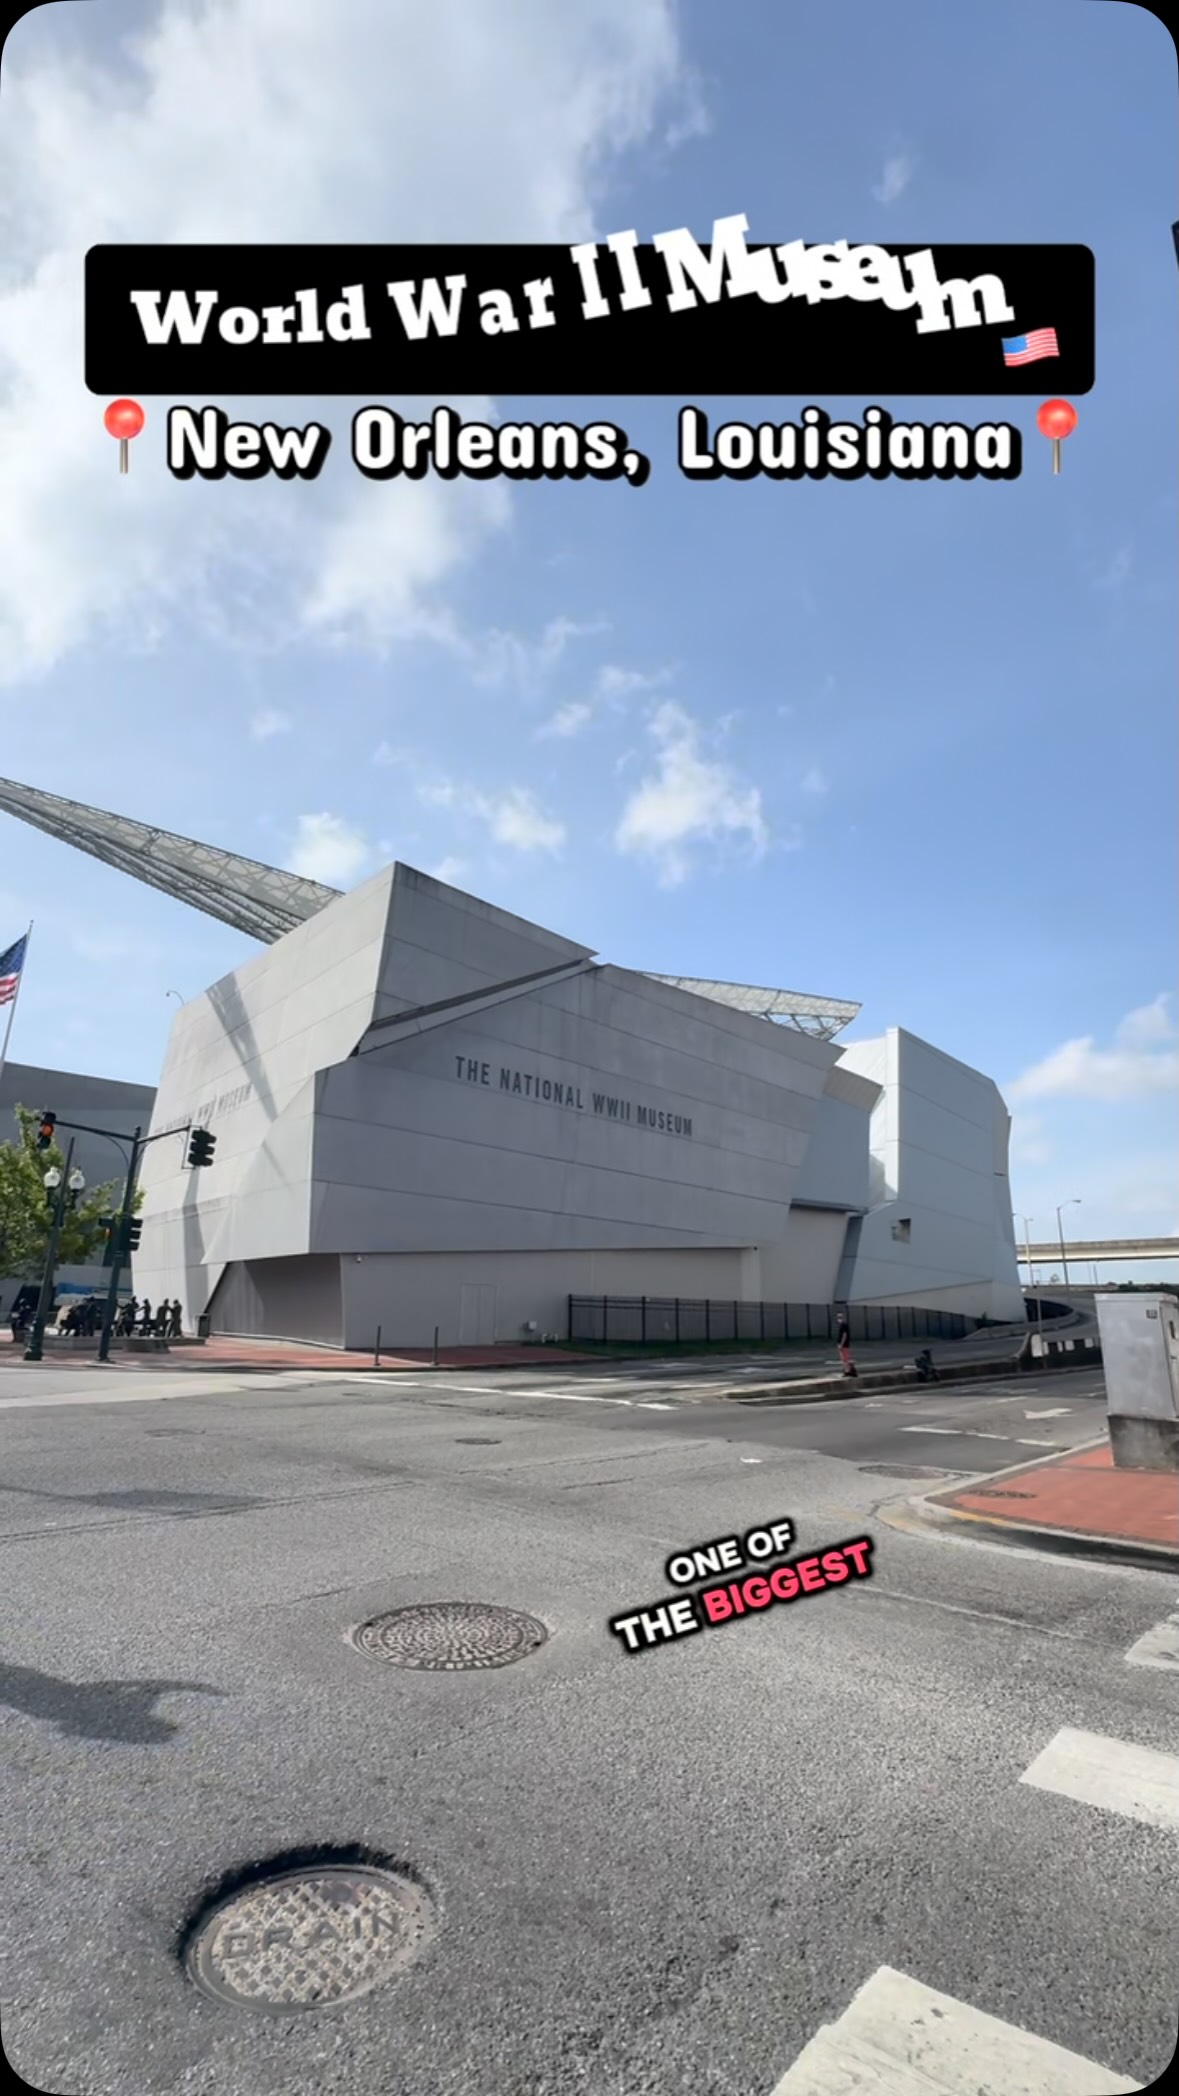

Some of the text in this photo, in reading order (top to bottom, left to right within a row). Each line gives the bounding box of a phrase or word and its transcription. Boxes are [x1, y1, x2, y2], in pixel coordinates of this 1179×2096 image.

[455, 1055, 693, 1138] THE NATIONAL WWII MUSEUM
[222, 1910, 401, 1960] DRAIN
